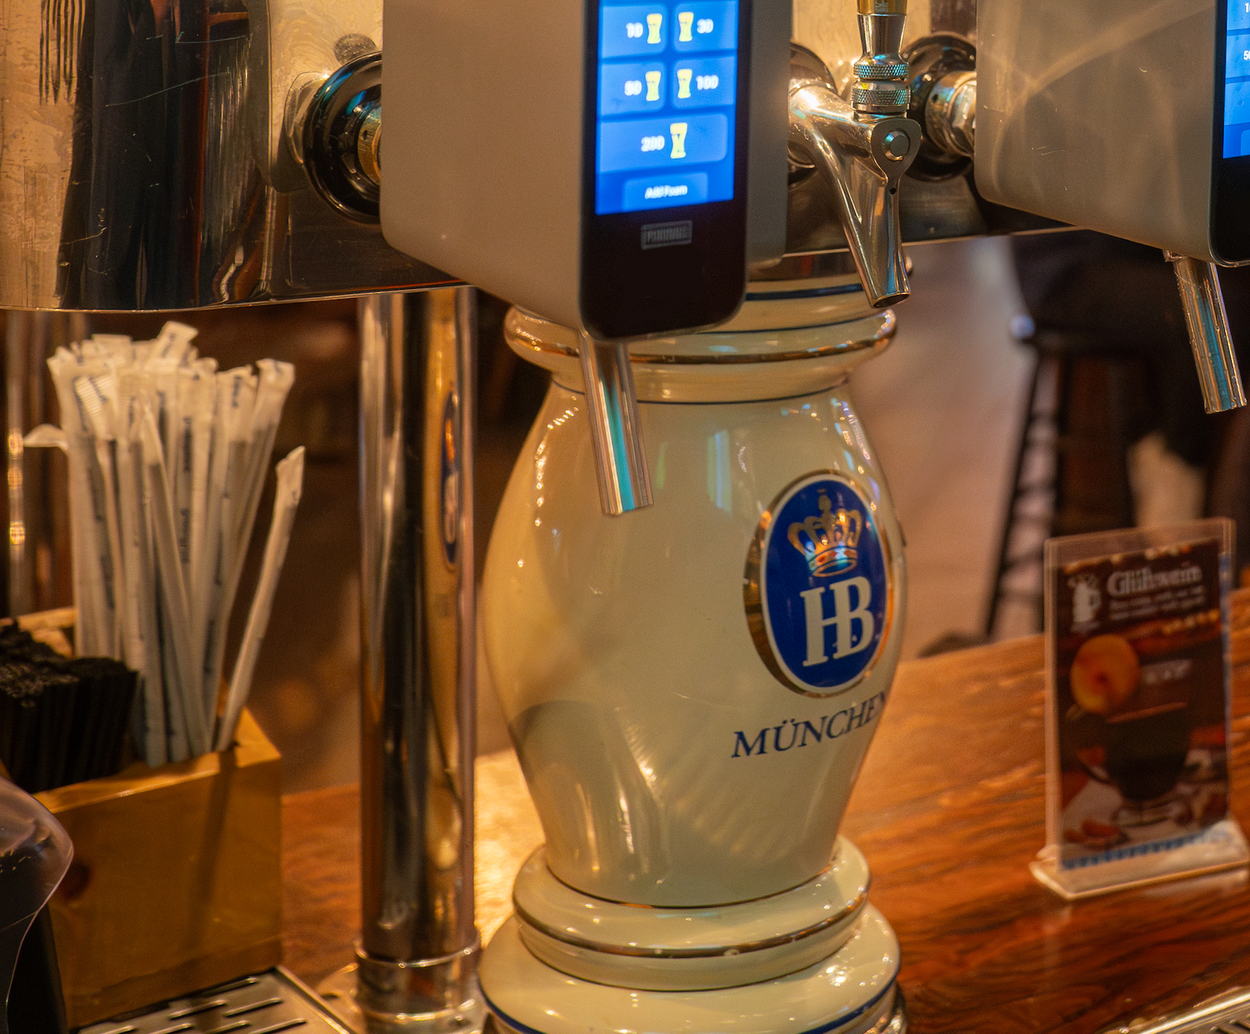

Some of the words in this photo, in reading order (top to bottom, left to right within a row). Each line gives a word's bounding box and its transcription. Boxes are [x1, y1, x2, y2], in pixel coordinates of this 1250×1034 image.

[695, 75, 720, 91] 100
[640, 135, 665, 153] 200
[800, 575, 875, 667] HB
